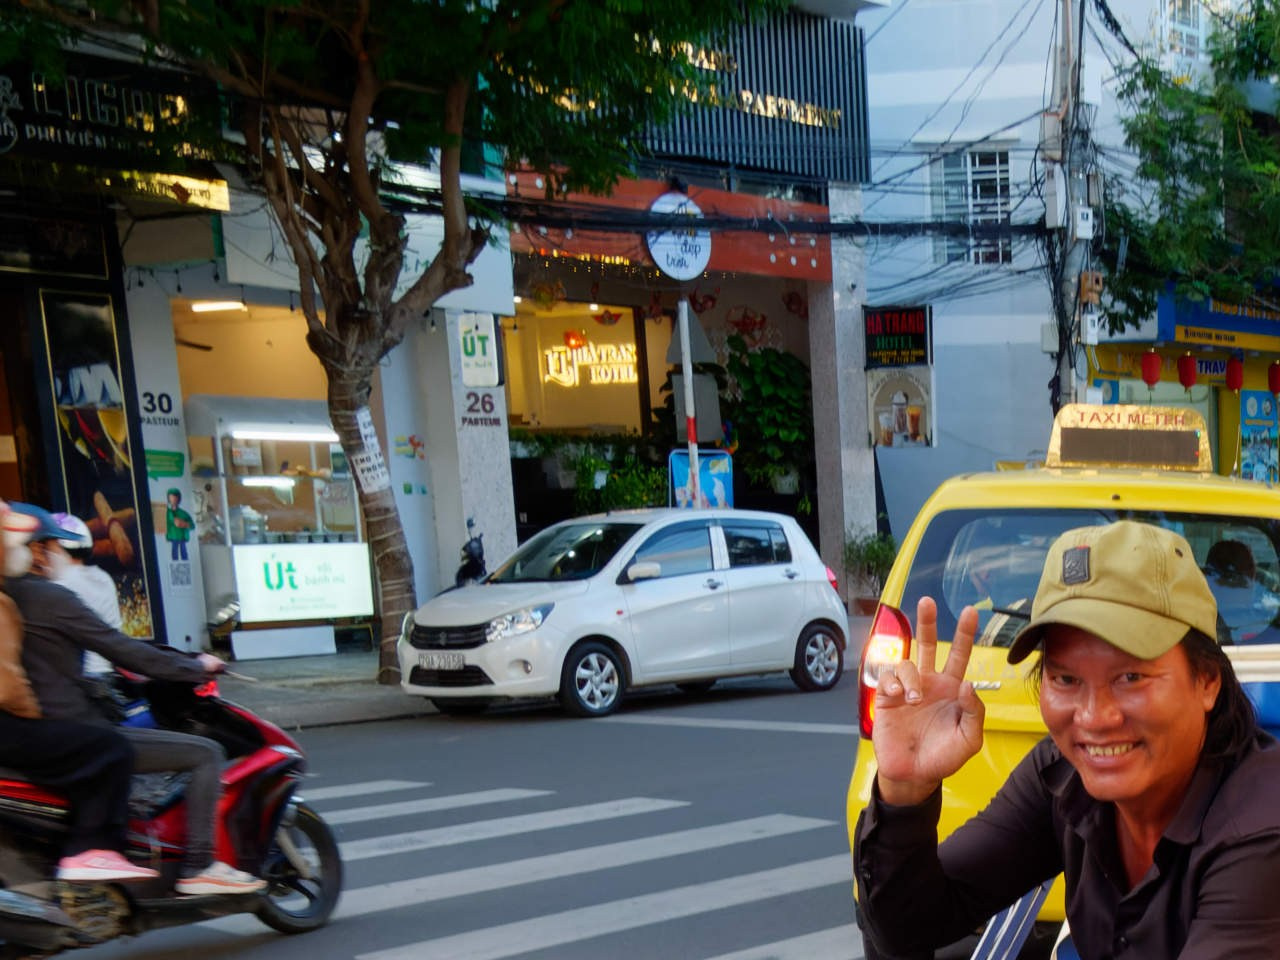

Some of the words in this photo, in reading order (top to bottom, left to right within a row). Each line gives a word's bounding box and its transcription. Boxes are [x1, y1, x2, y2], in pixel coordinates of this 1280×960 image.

[726, 89, 842, 129] APARTMENT
[143, 392, 173, 414] 30
[466, 391, 495, 414] 26
[140, 416, 180, 426] PASTEUR
[462, 416, 502, 427] PASTEUR
[1078, 411, 1121, 423] TAXI
[1127, 413, 1185, 426] METER
[263, 552, 298, 590] Út
